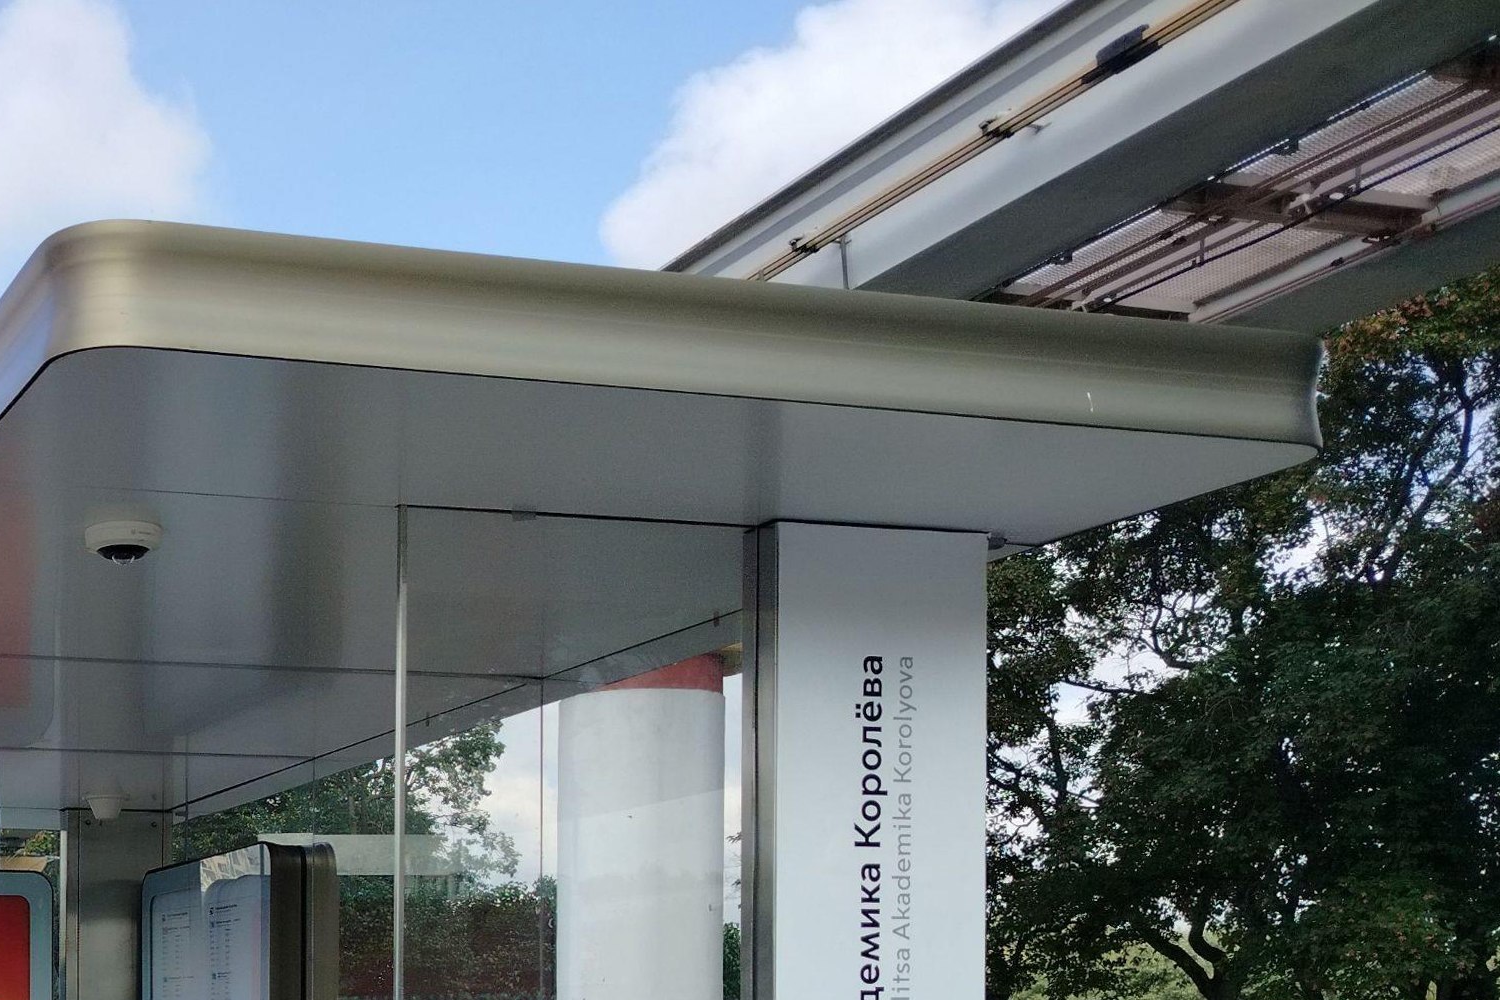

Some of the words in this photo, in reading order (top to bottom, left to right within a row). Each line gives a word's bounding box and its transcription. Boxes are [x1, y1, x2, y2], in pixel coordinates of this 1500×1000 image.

[853, 654, 888, 848] Королёва
[892, 655, 918, 784] Korolyova
[890, 792, 913, 940] Akademika
